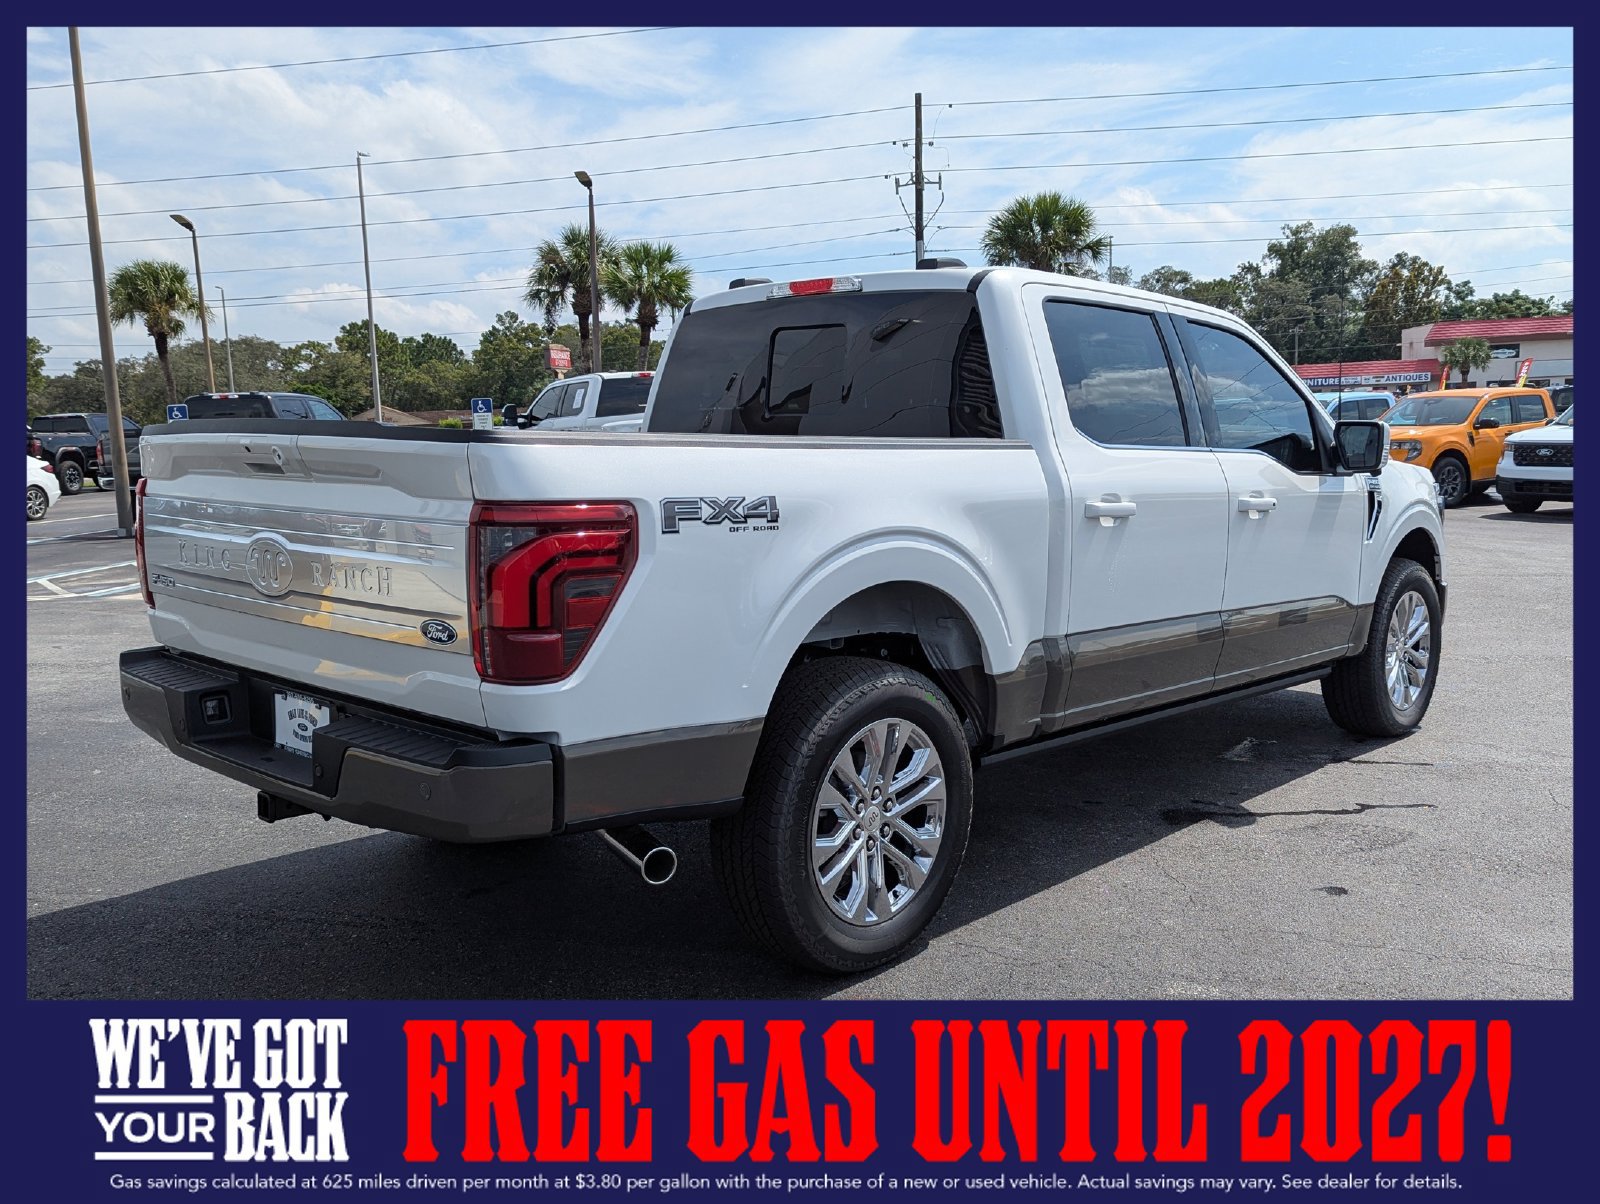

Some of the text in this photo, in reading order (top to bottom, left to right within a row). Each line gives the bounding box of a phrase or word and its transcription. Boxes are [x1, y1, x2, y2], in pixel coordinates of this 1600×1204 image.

[1385, 374, 1429, 382] ANTIQUES
[660, 496, 779, 534] FX4
[179, 539, 393, 597] KING RANCH
